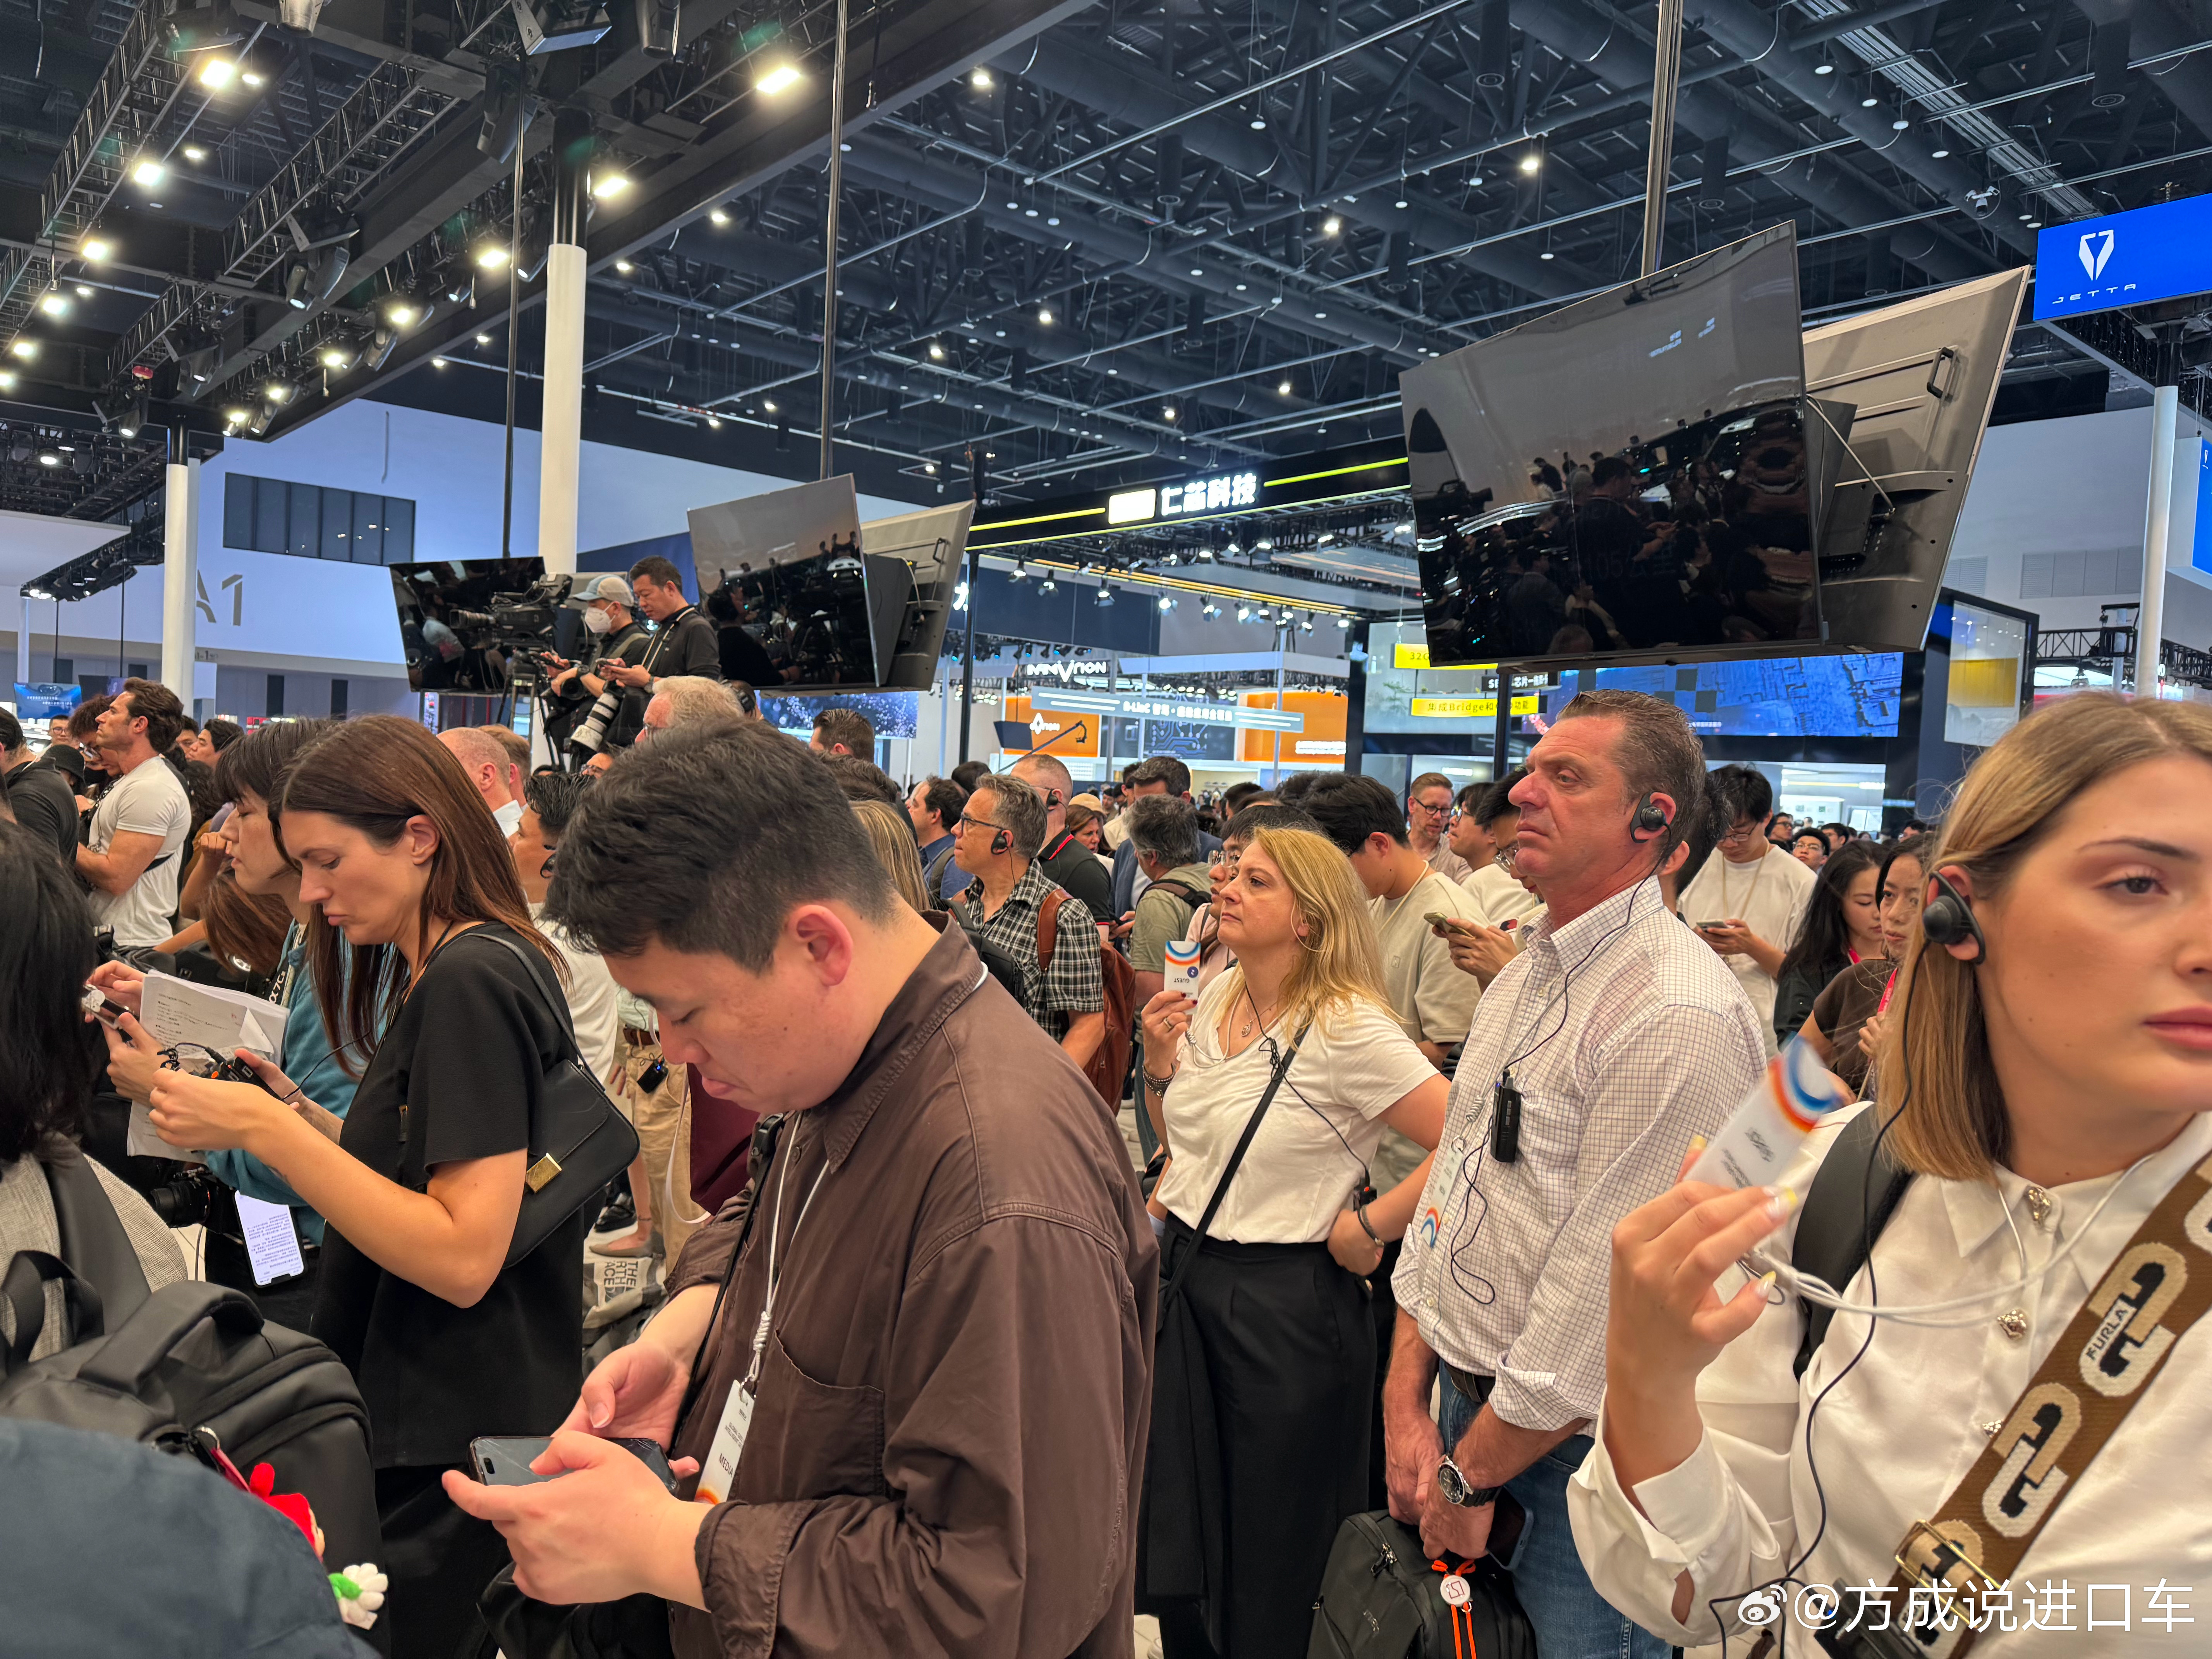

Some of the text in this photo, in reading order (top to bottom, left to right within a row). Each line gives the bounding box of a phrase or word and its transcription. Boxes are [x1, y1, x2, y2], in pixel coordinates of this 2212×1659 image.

[2052, 283, 2136, 304] JETTA
[1161, 473, 1257, 516] 仁芯科技
[604, 1261, 616, 1285] ACE
[615, 1261, 627, 1285] RTH
[626, 1261, 638, 1286] THE
[2086, 1310, 2128, 1361] FURLA
[719, 1453, 733, 1478] MEDIA
